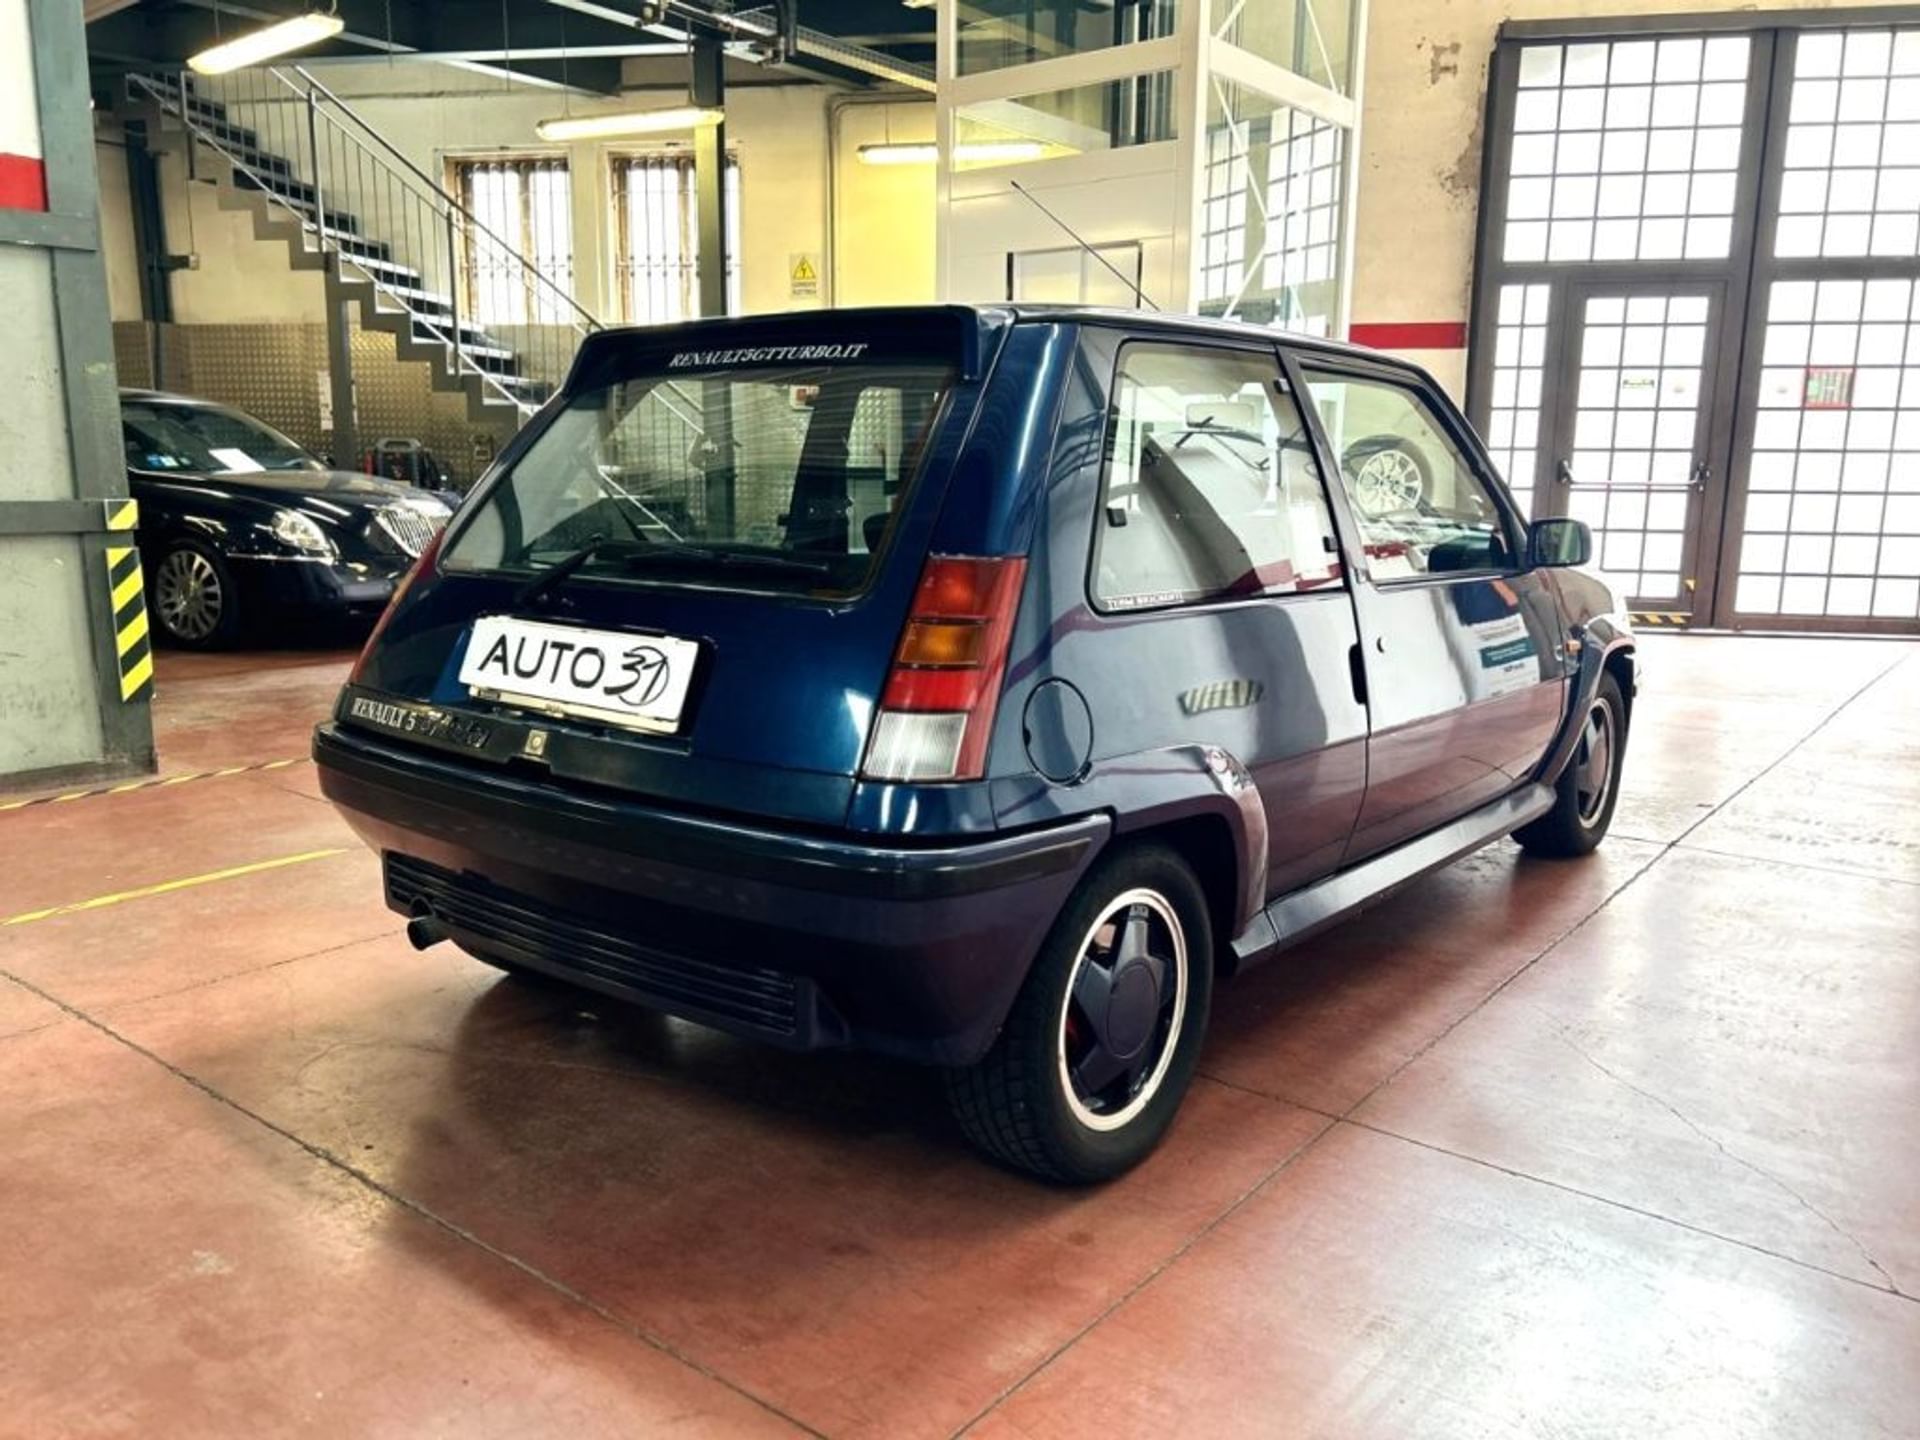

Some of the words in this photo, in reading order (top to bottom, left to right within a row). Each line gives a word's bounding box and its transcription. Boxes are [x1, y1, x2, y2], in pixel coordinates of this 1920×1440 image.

[669, 343, 868, 368] RENAULT5GTTURBO.IT
[477, 633, 605, 689] AUTO
[351, 697, 407, 729] RENAULT
[405, 711, 416, 731] 5
